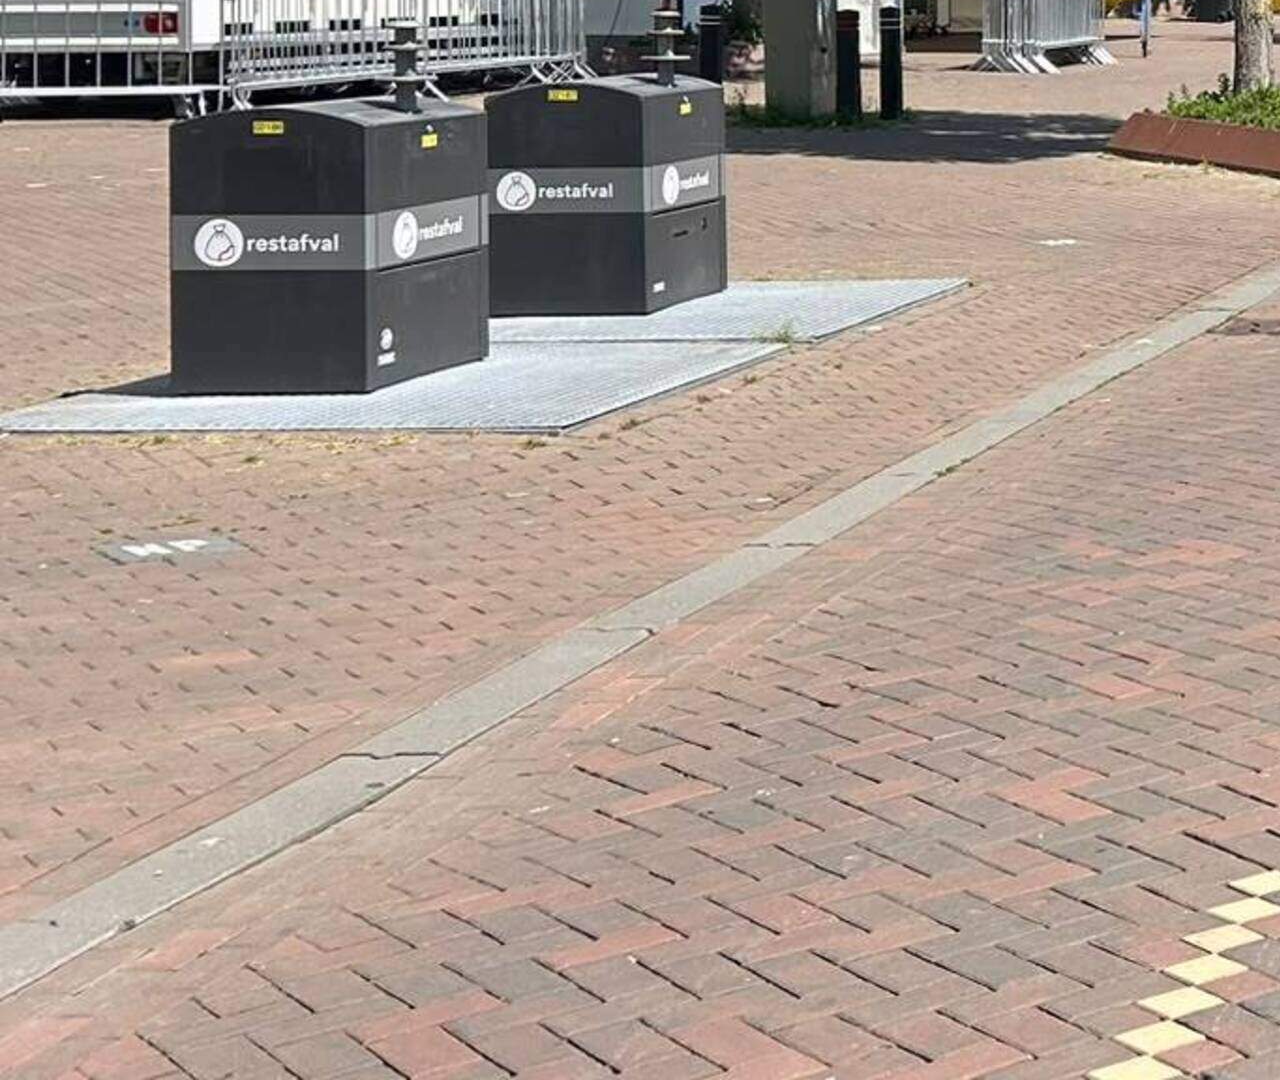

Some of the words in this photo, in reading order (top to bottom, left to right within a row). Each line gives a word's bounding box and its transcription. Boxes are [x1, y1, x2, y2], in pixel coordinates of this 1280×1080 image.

[538, 182, 614, 199] restafval
[419, 215, 463, 241] restafval
[246, 233, 340, 253] restafval
